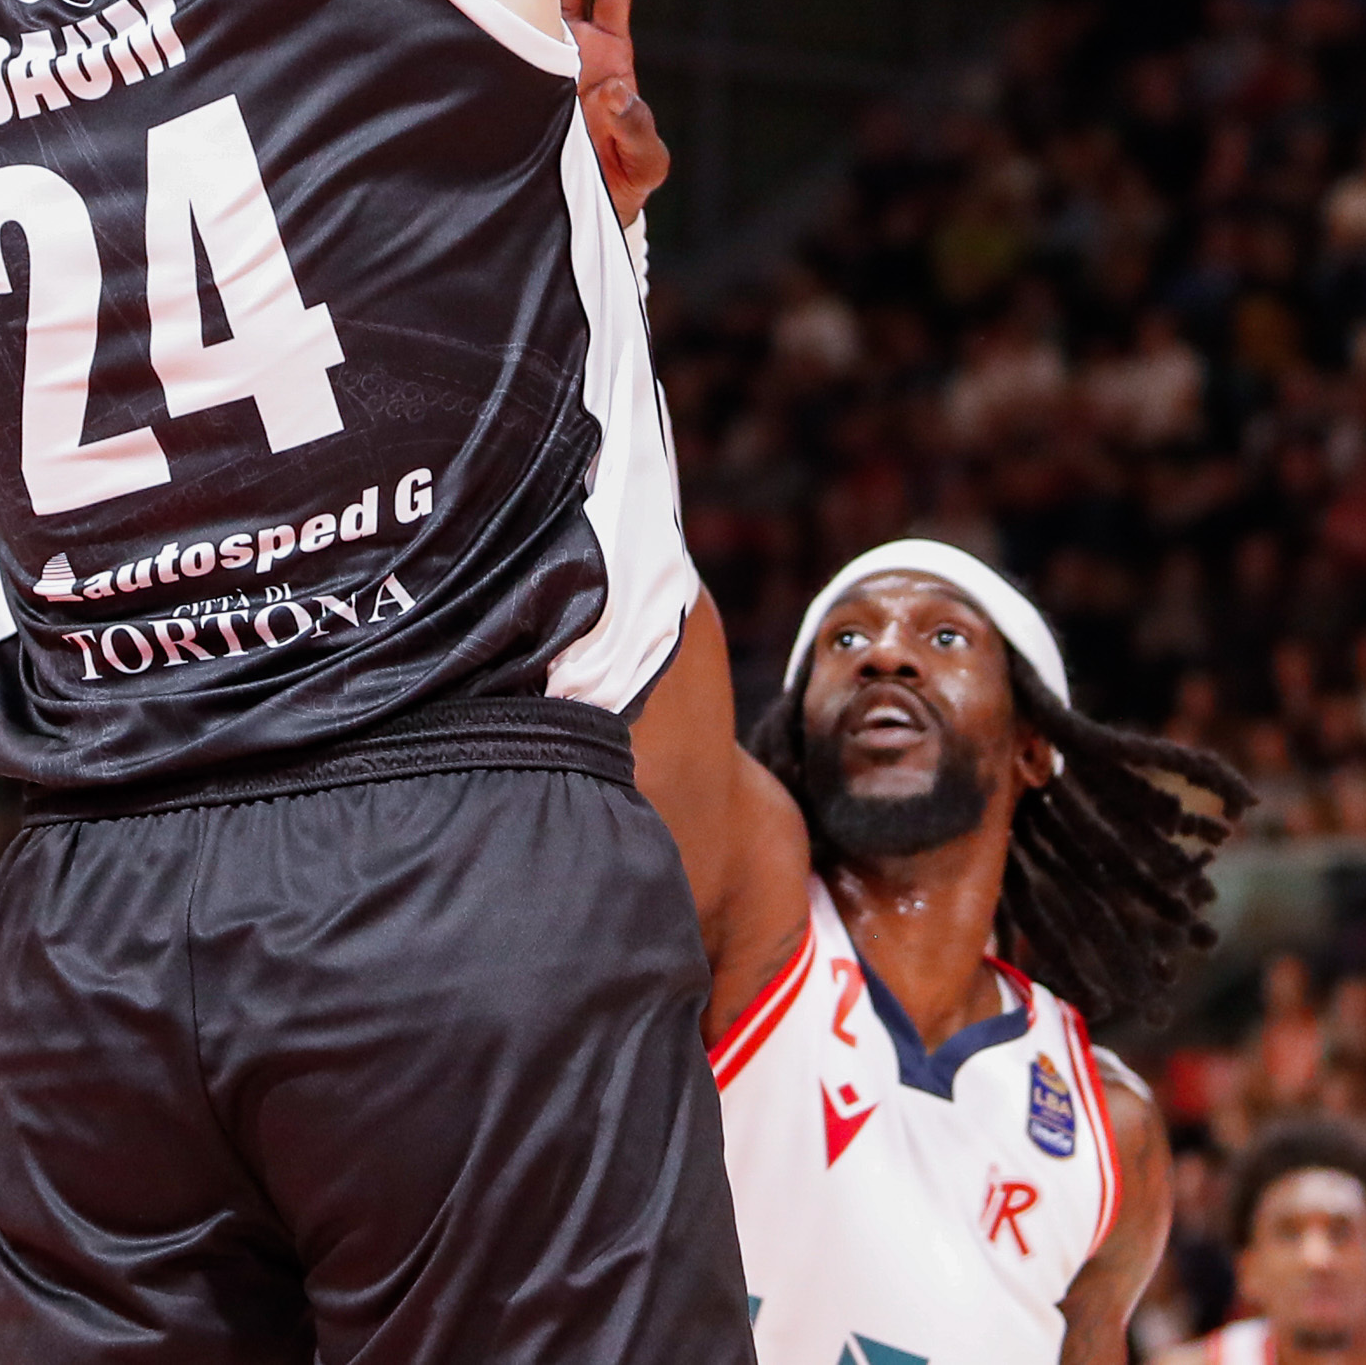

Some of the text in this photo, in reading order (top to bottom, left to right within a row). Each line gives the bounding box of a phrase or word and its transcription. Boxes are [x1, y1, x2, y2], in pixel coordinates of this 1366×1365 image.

[81, 467, 434, 601] autosped G
[61, 572, 417, 682] TORTONA
[172, 582, 292, 617] CITTÀ DI
